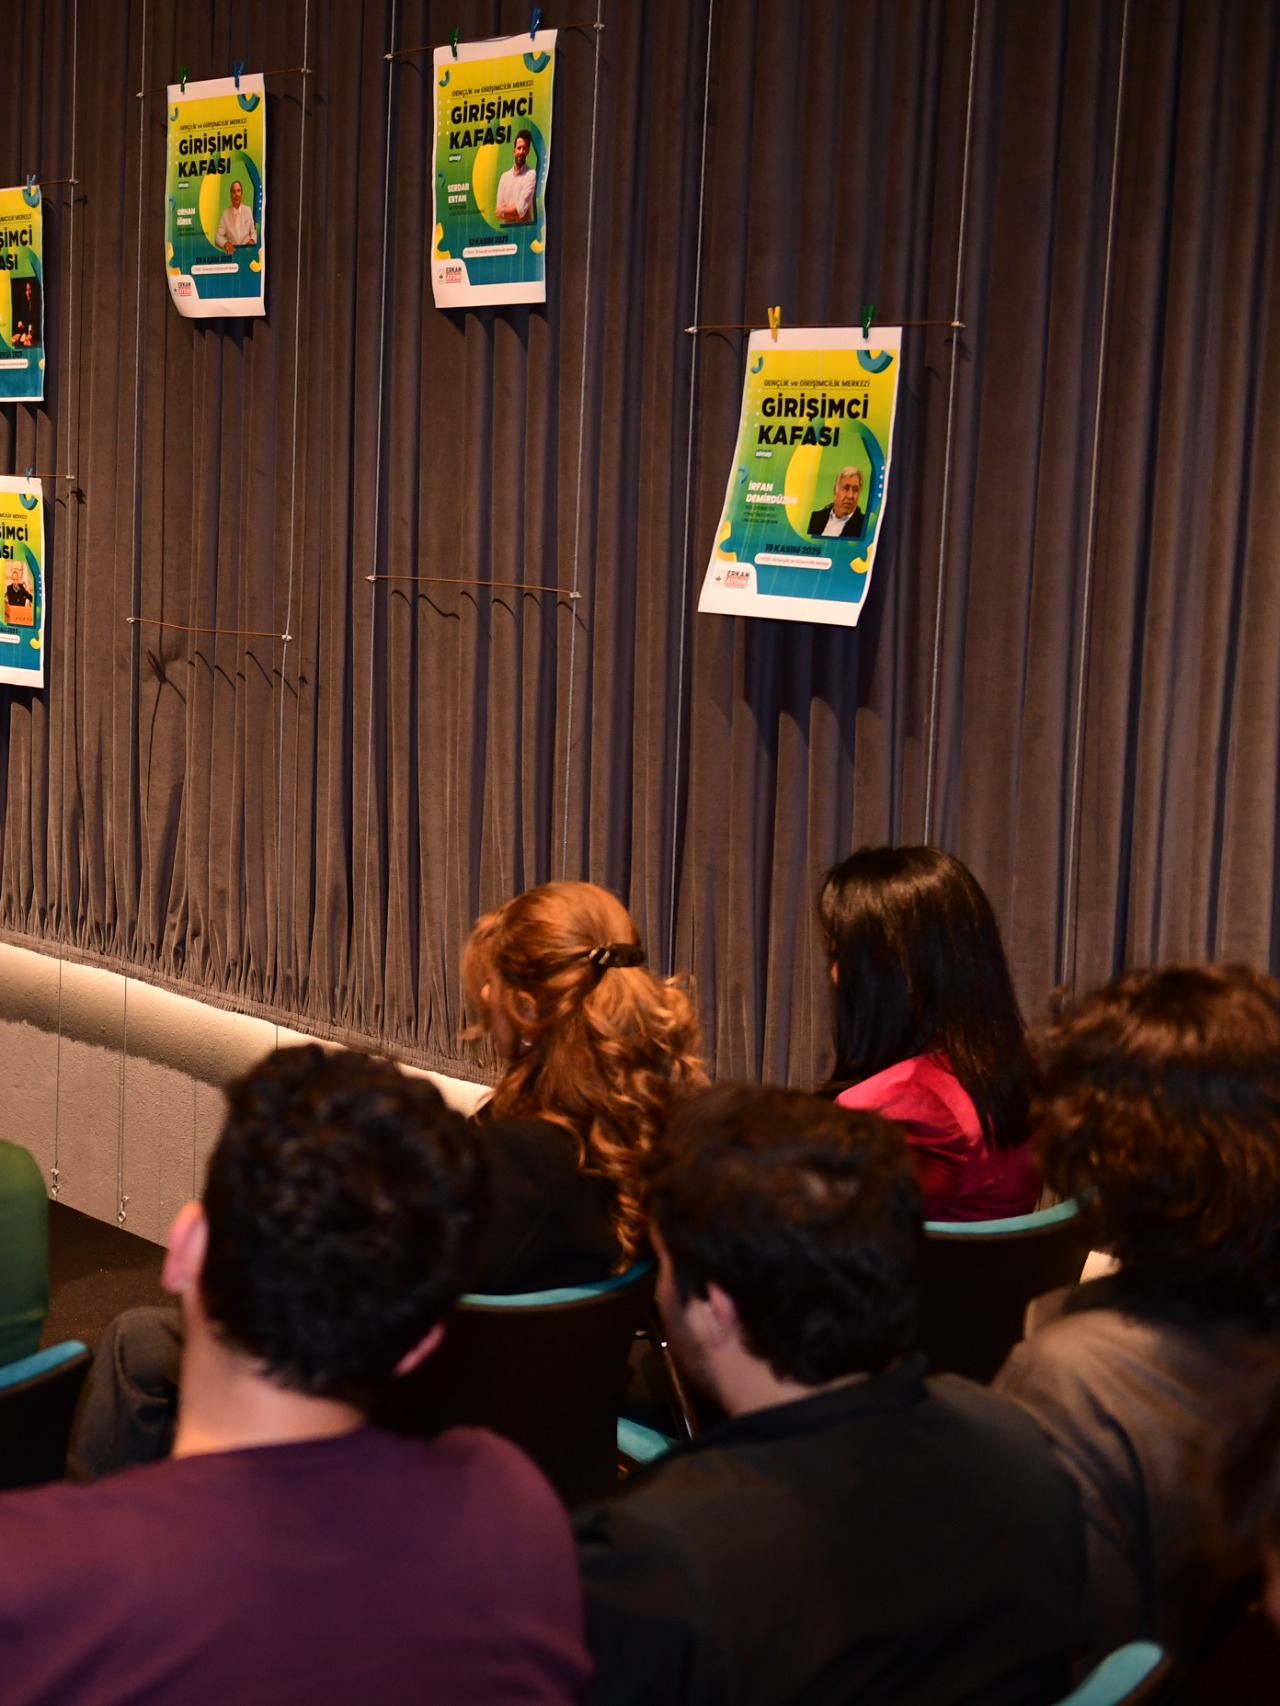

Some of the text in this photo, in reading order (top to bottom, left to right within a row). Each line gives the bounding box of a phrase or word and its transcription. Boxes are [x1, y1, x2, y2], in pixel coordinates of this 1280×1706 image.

[450, 92, 533, 124] GİRİŞİMCİ
[178, 128, 248, 156] GİRİŞİMCİ
[449, 125, 512, 150] KAFASI
[178, 158, 231, 178] KAFASI
[448, 182, 470, 193] SERDAR
[448, 194, 467, 204] ERTAN
[764, 379, 789, 390] GENÇLİK
[799, 379, 840, 390] GİRİŞİMCİLİK
[842, 379, 870, 388] MERKEZİ
[762, 392, 869, 422] GİRİŞİMCİ
[757, 425, 840, 447] KAFASI
[748, 480, 774, 492] İRFAN
[765, 543, 822, 556] 19 KASIM 2025
[727, 570, 750, 578] ERKAN
